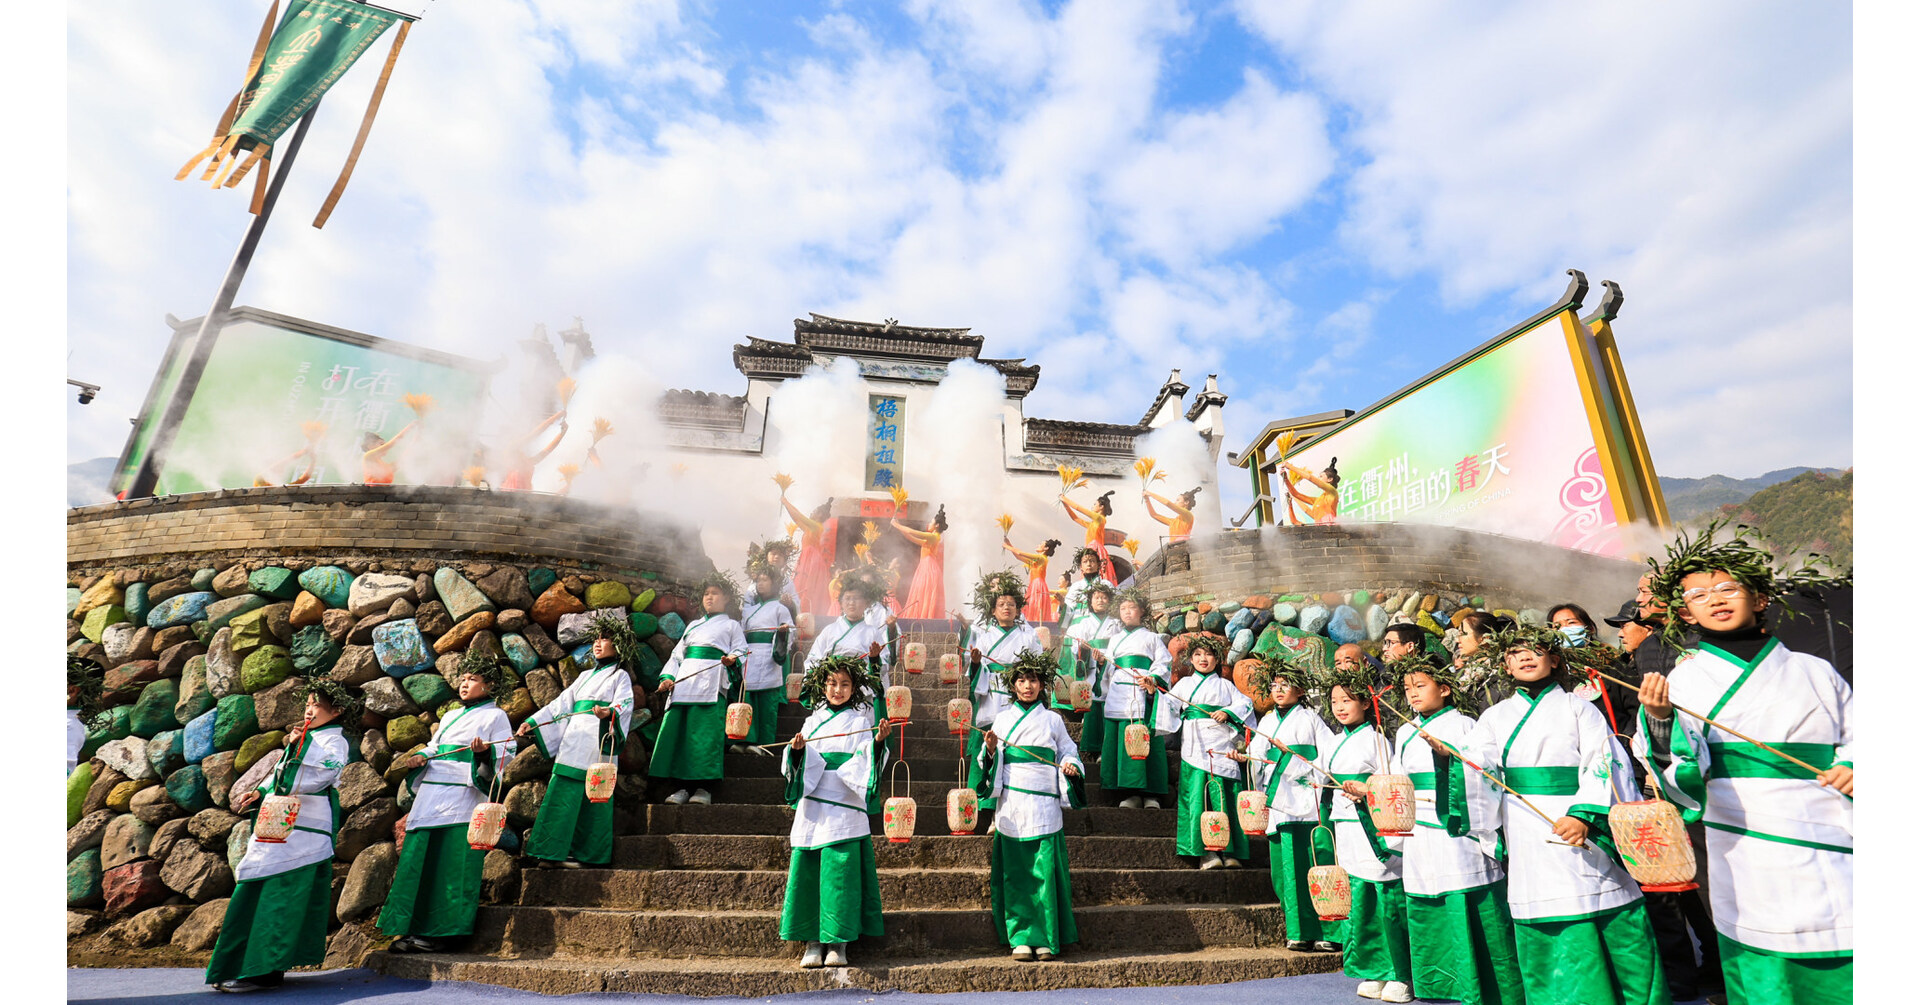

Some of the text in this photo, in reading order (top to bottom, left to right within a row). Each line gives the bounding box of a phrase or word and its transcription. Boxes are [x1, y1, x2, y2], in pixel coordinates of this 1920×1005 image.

[872, 398, 899, 488] 梧桐祖殿
[1467, 498, 1480, 510] OF
[1481, 487, 1512, 504] CHINA
[1387, 788, 1409, 816] 春
[903, 808, 914, 826] 春
[1630, 823, 1670, 859] 春
[1333, 879, 1350, 901] 春
